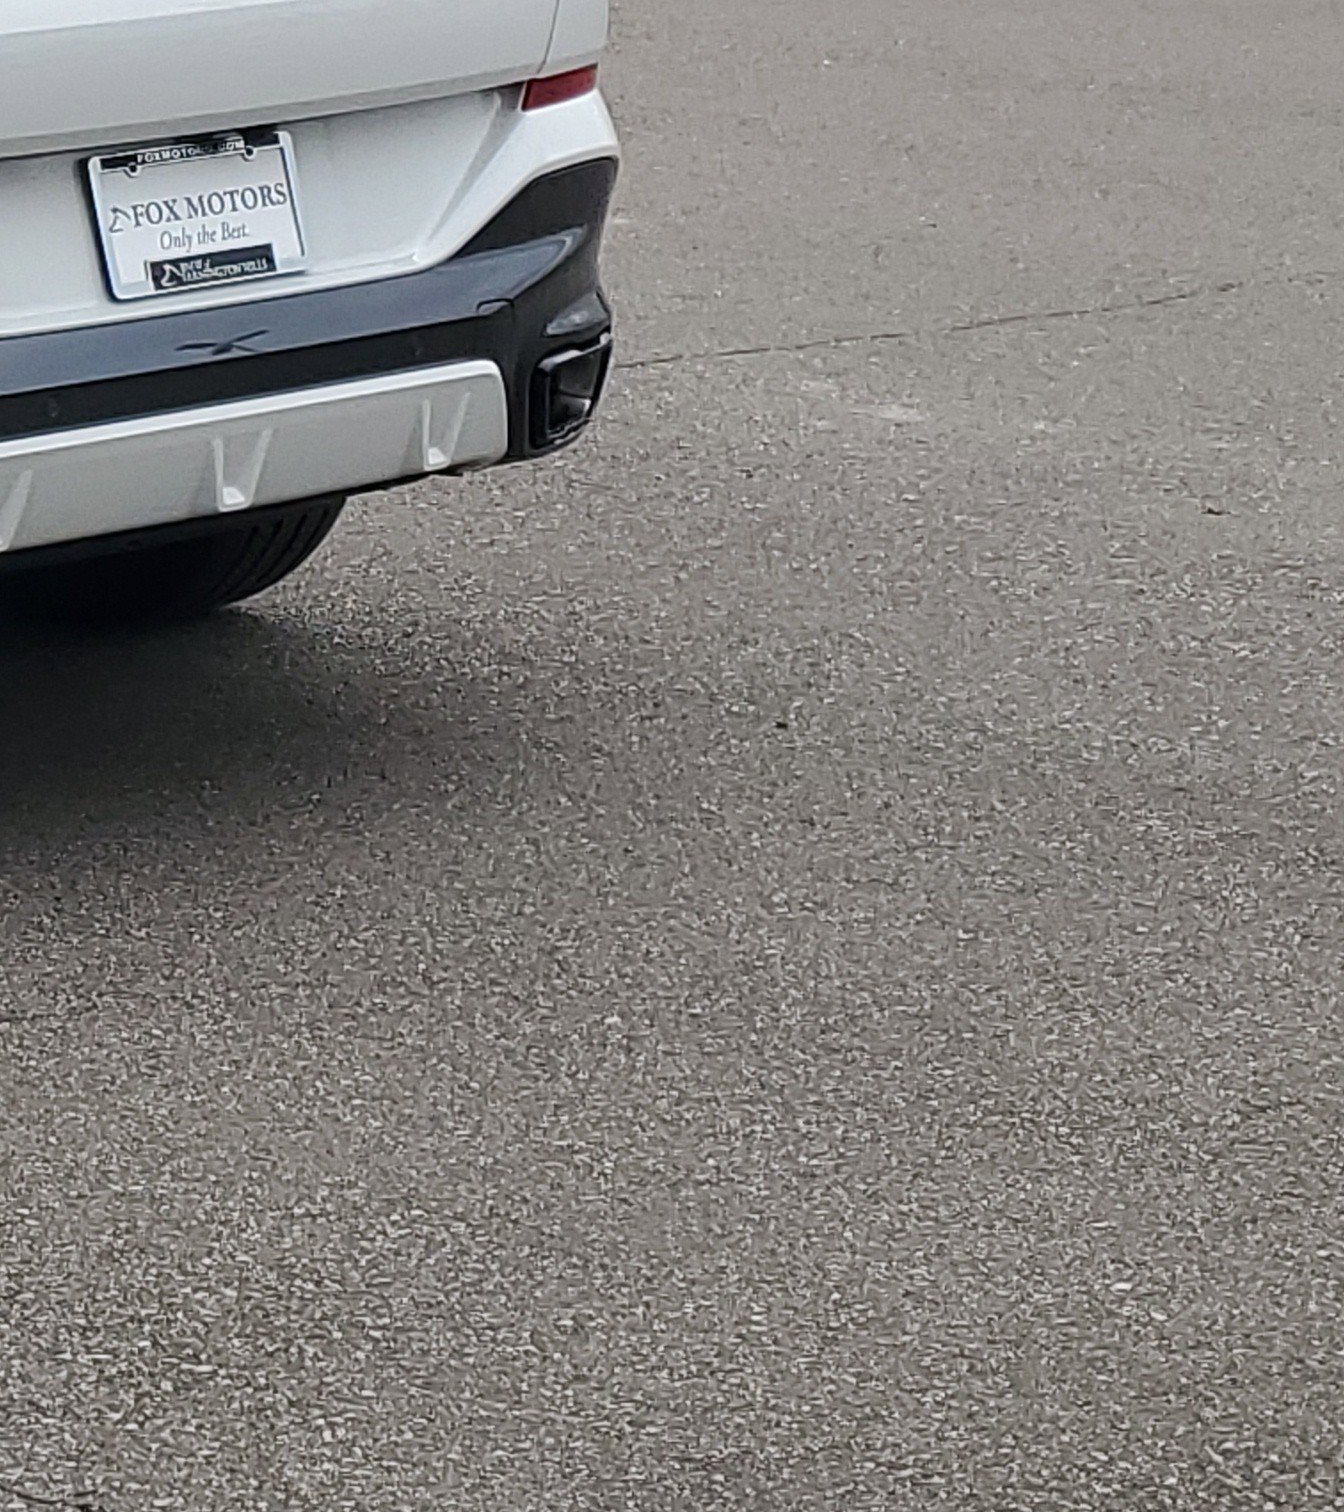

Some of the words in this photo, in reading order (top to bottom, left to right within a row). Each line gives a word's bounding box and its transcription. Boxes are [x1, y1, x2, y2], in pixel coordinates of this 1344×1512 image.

[130, 196, 182, 229] FOX
[183, 182, 288, 220] MOTORS
[159, 227, 193, 253] Only
[196, 223, 217, 245] the
